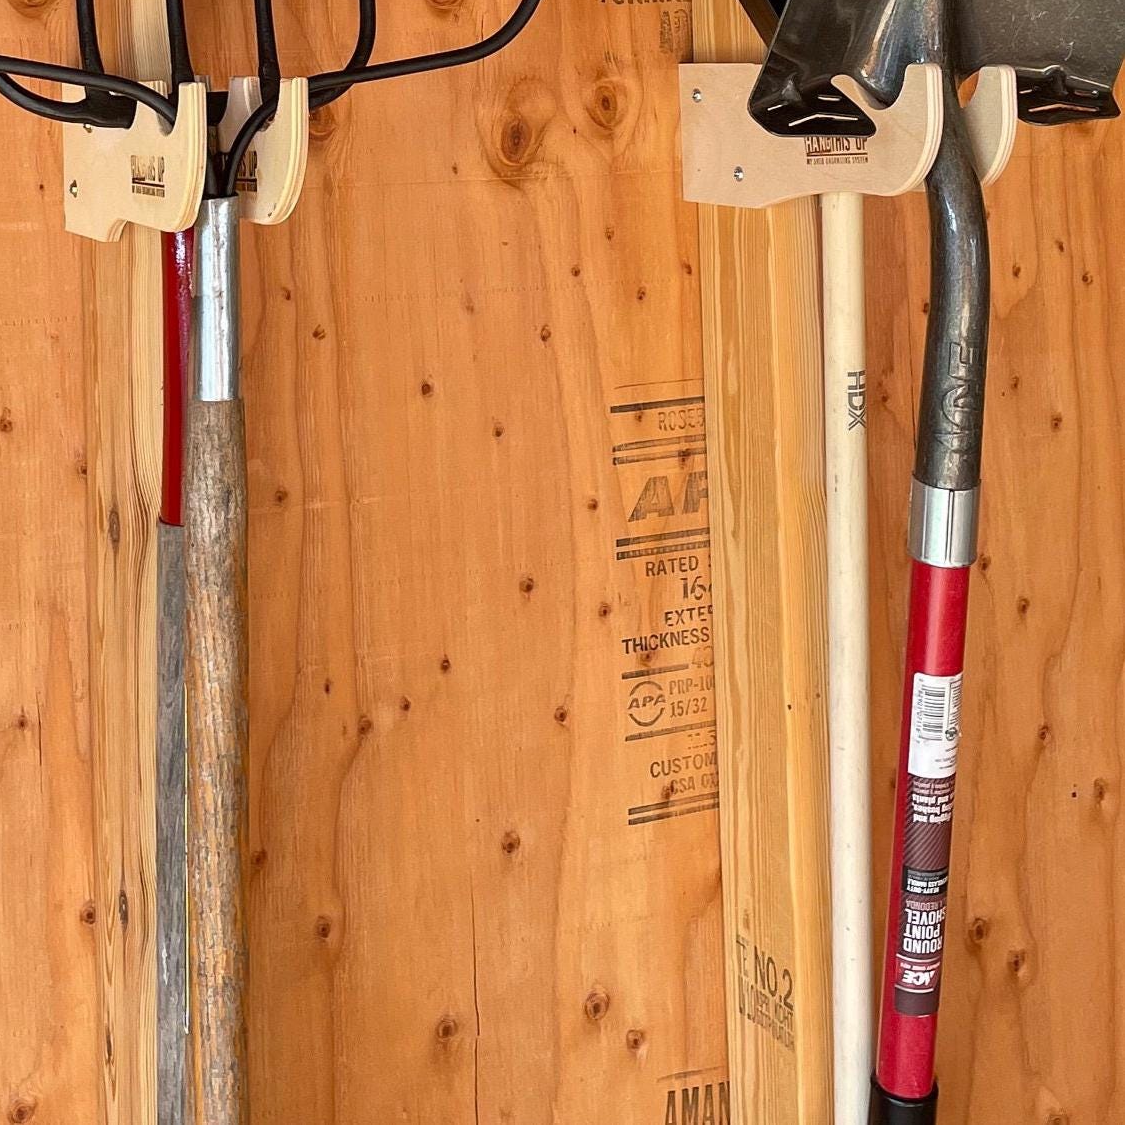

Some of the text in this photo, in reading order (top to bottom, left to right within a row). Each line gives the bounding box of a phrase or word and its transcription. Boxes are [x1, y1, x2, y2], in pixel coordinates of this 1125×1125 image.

[847, 370, 867, 431] HDX
[645, 555, 699, 577] RATED
[621, 627, 710, 654] THICKNESS
[669, 675, 715, 695] PRP-10
[627, 694, 667, 710] APA
[670, 696, 708, 719] 15/32
[903, 923, 941, 940] POINT
[903, 937, 942, 954] ROUND
[754, 945, 794, 1012] NO.2
[902, 970, 935, 986] ACE
